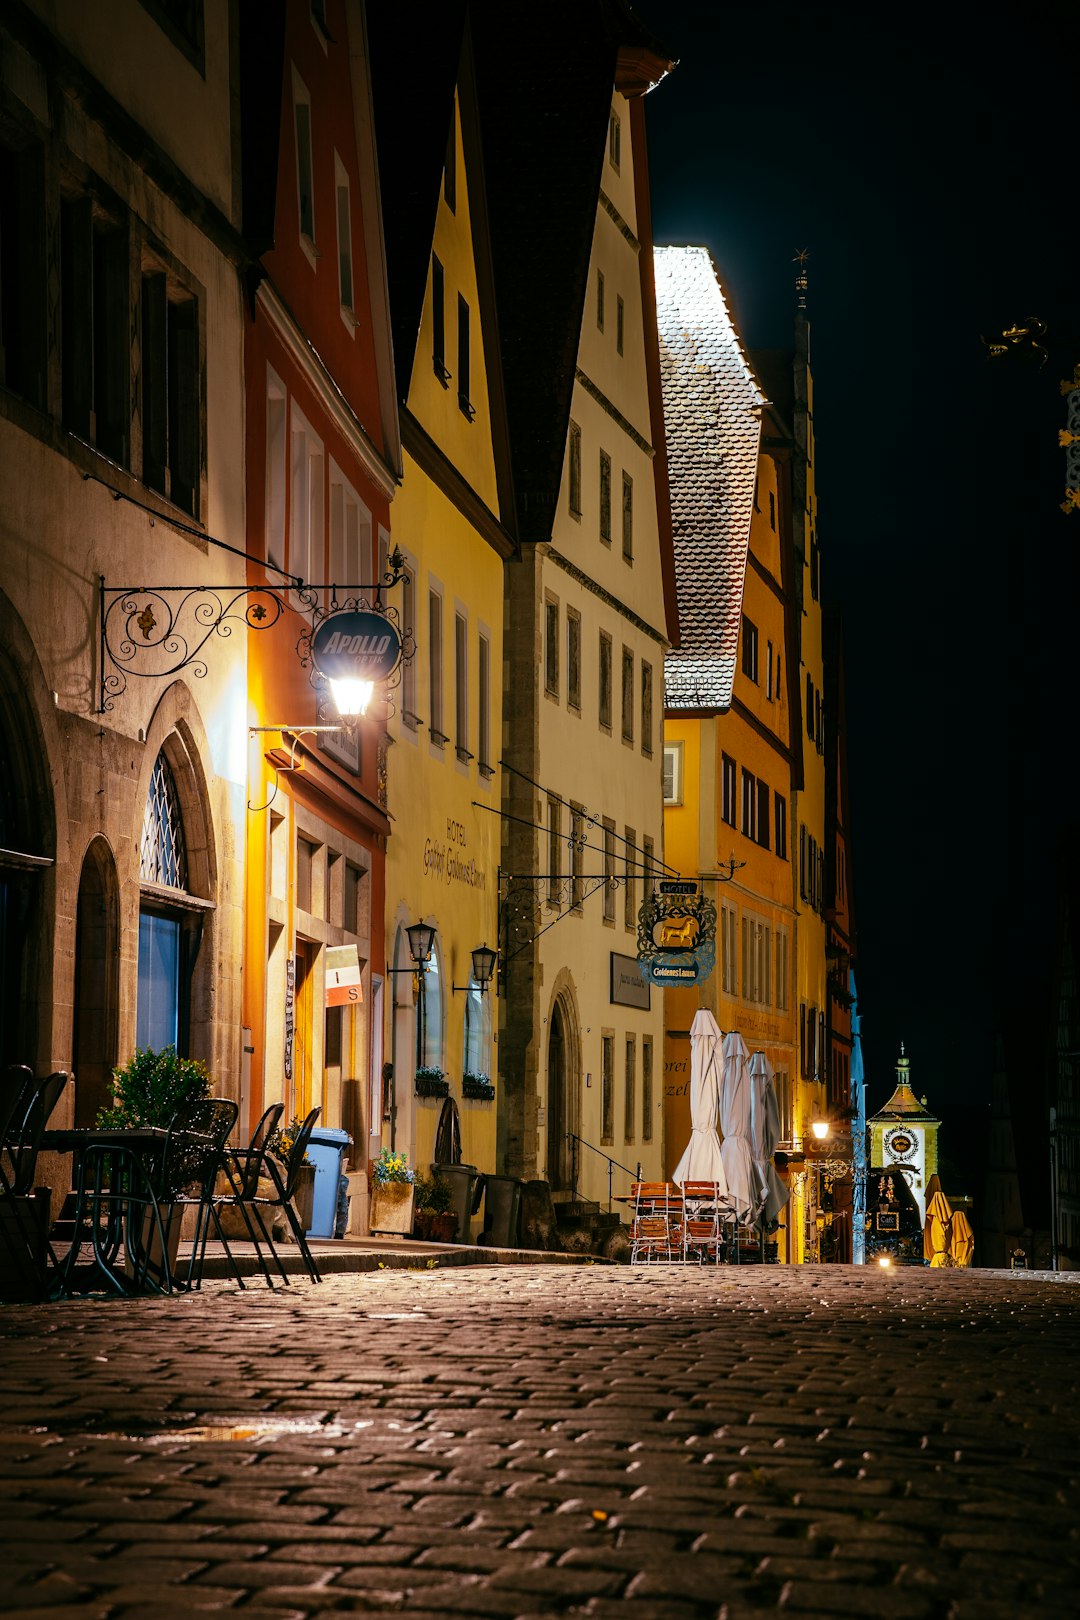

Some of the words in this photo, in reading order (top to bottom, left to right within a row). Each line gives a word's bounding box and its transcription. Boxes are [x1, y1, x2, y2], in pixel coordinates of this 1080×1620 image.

[322, 631, 392, 655] APOLLO
[354, 655, 384, 664] OPTIK
[446, 817, 467, 847] HOTEL
[663, 884, 692, 894] HOTEL
[348, 987, 359, 1001] S
